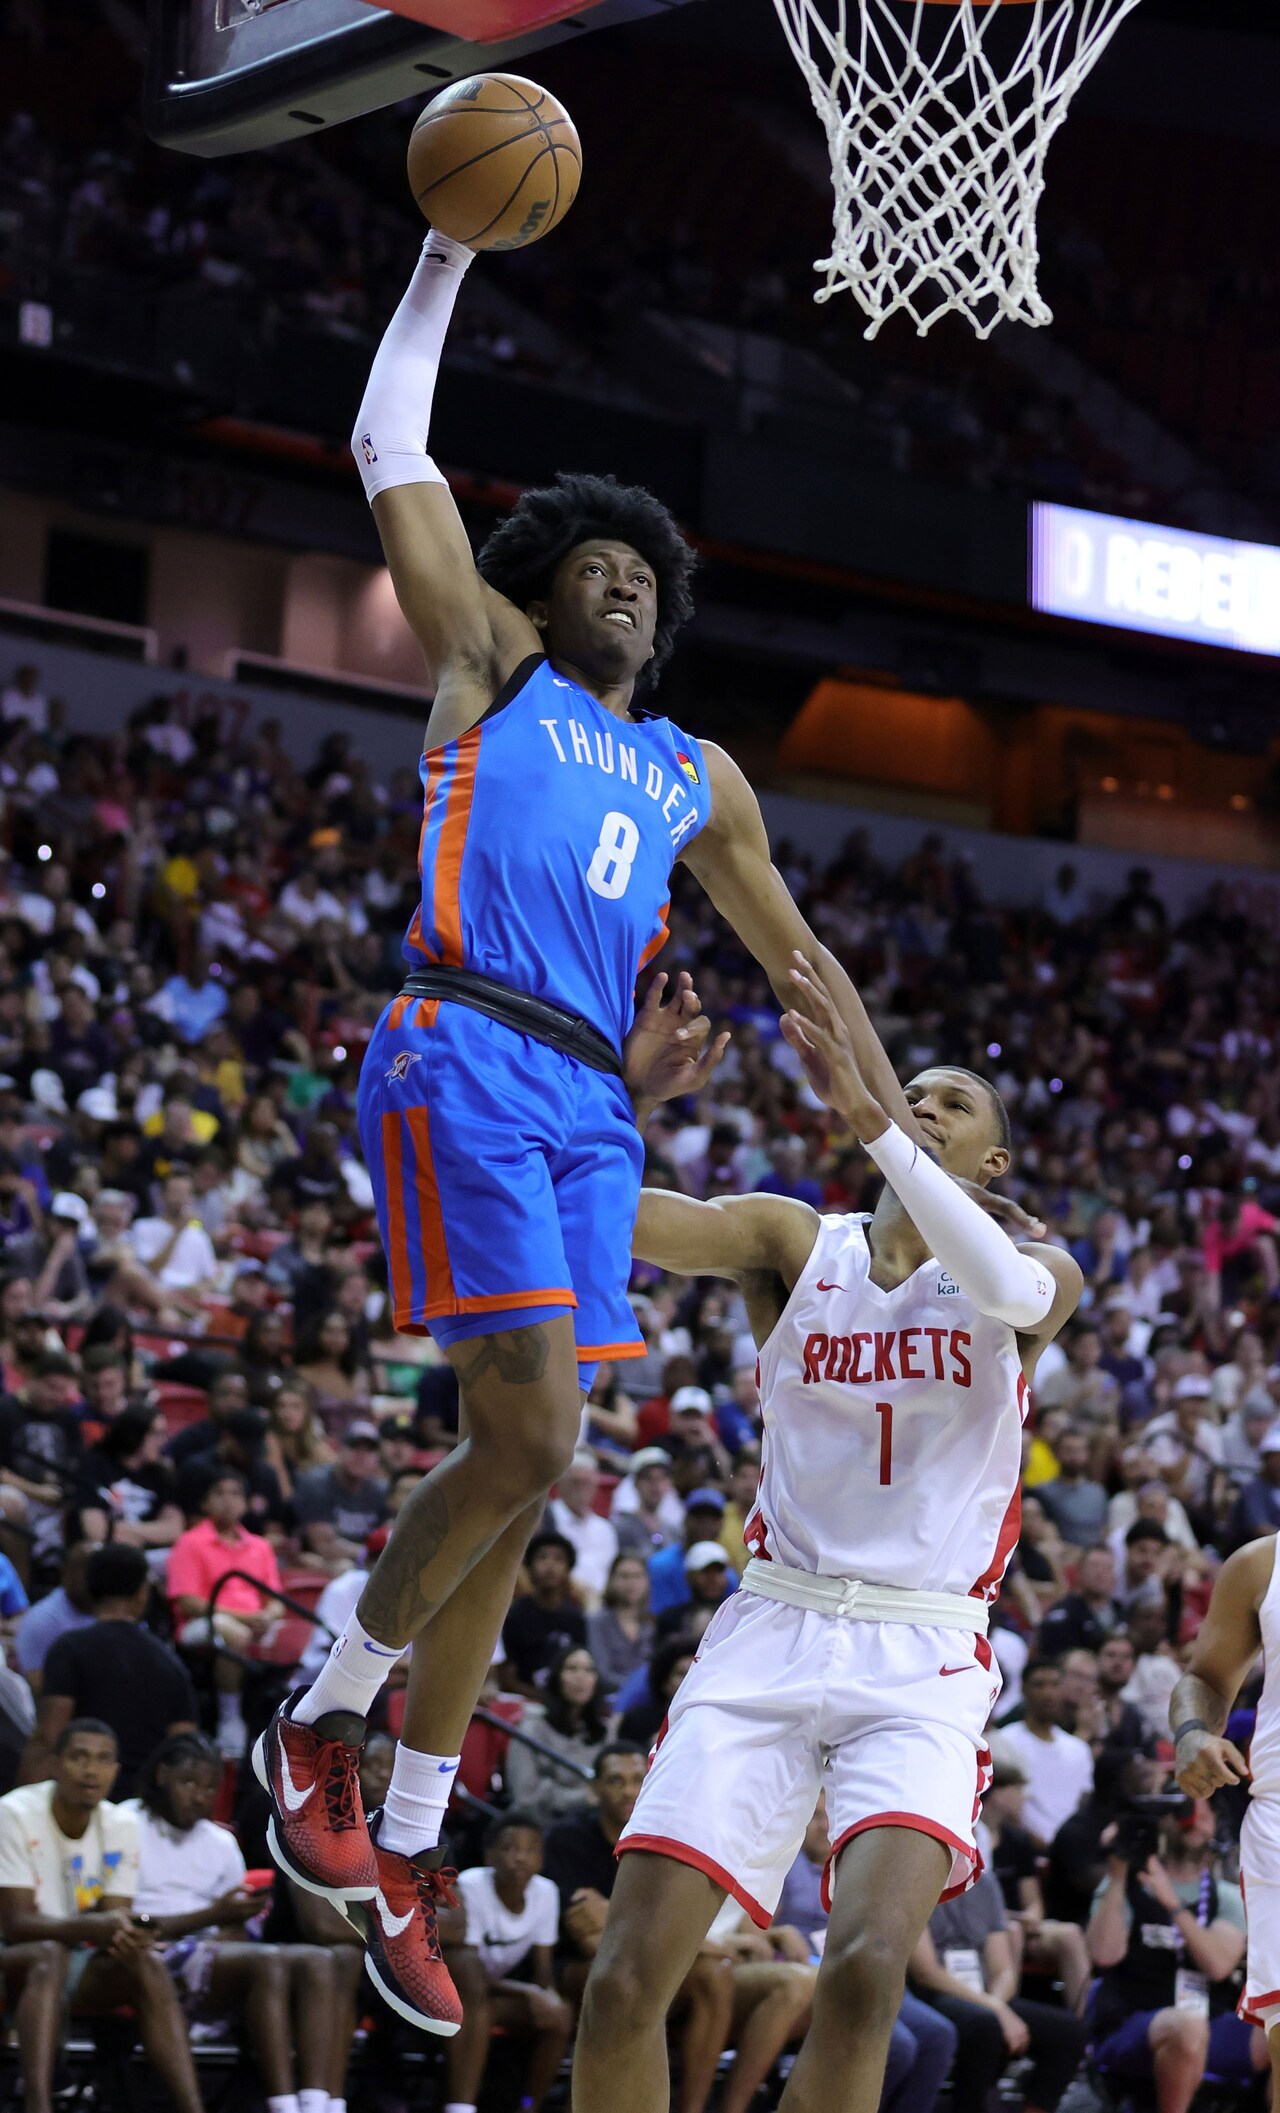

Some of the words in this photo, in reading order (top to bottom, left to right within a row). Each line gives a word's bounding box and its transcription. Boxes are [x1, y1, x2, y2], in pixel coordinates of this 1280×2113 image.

[538, 717, 699, 846] THUNDER
[586, 811, 640, 900] 8
[802, 1327, 972, 1388] ROCKETS
[875, 1402, 893, 1486] 1
